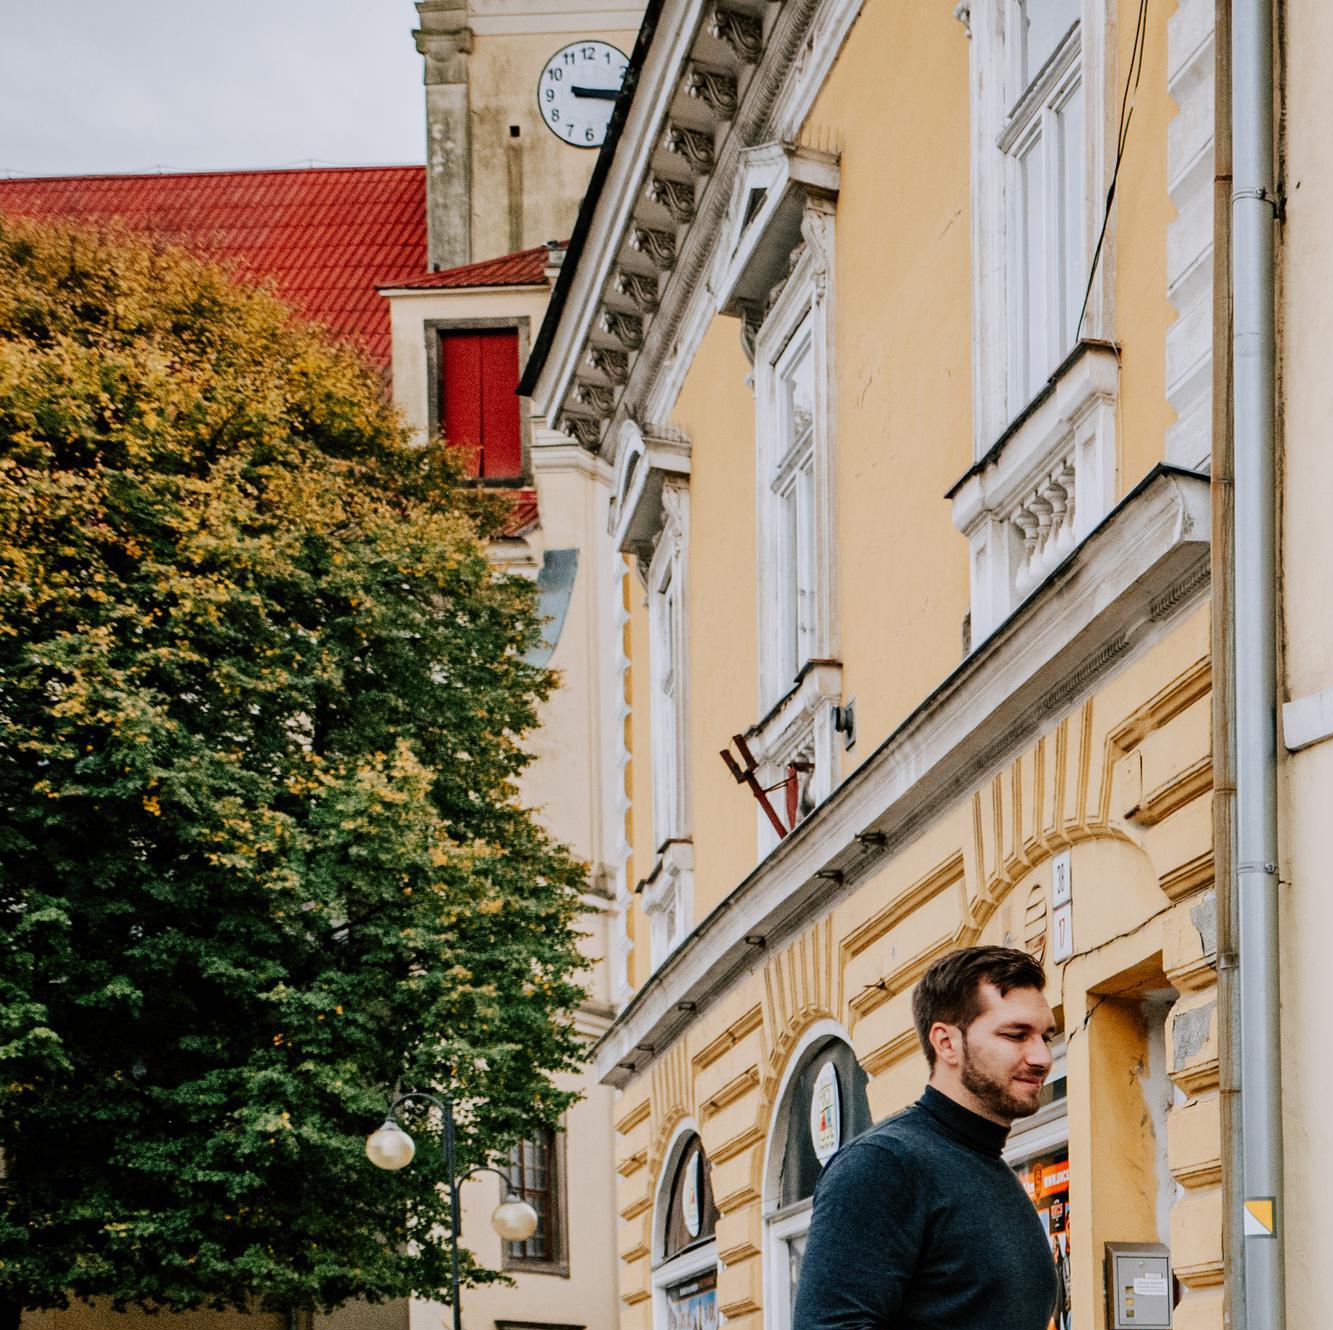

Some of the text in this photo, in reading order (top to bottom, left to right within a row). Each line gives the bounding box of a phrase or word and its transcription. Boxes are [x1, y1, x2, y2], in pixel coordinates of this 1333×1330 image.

[563, 52, 575, 65] 11
[581, 47, 595, 60] 12
[604, 52, 611, 65] 1
[548, 68, 563, 81] 10
[546, 88, 555, 102] 9
[551, 109, 560, 122] 8
[566, 124, 574, 137] 7
[585, 128, 594, 141] 6
